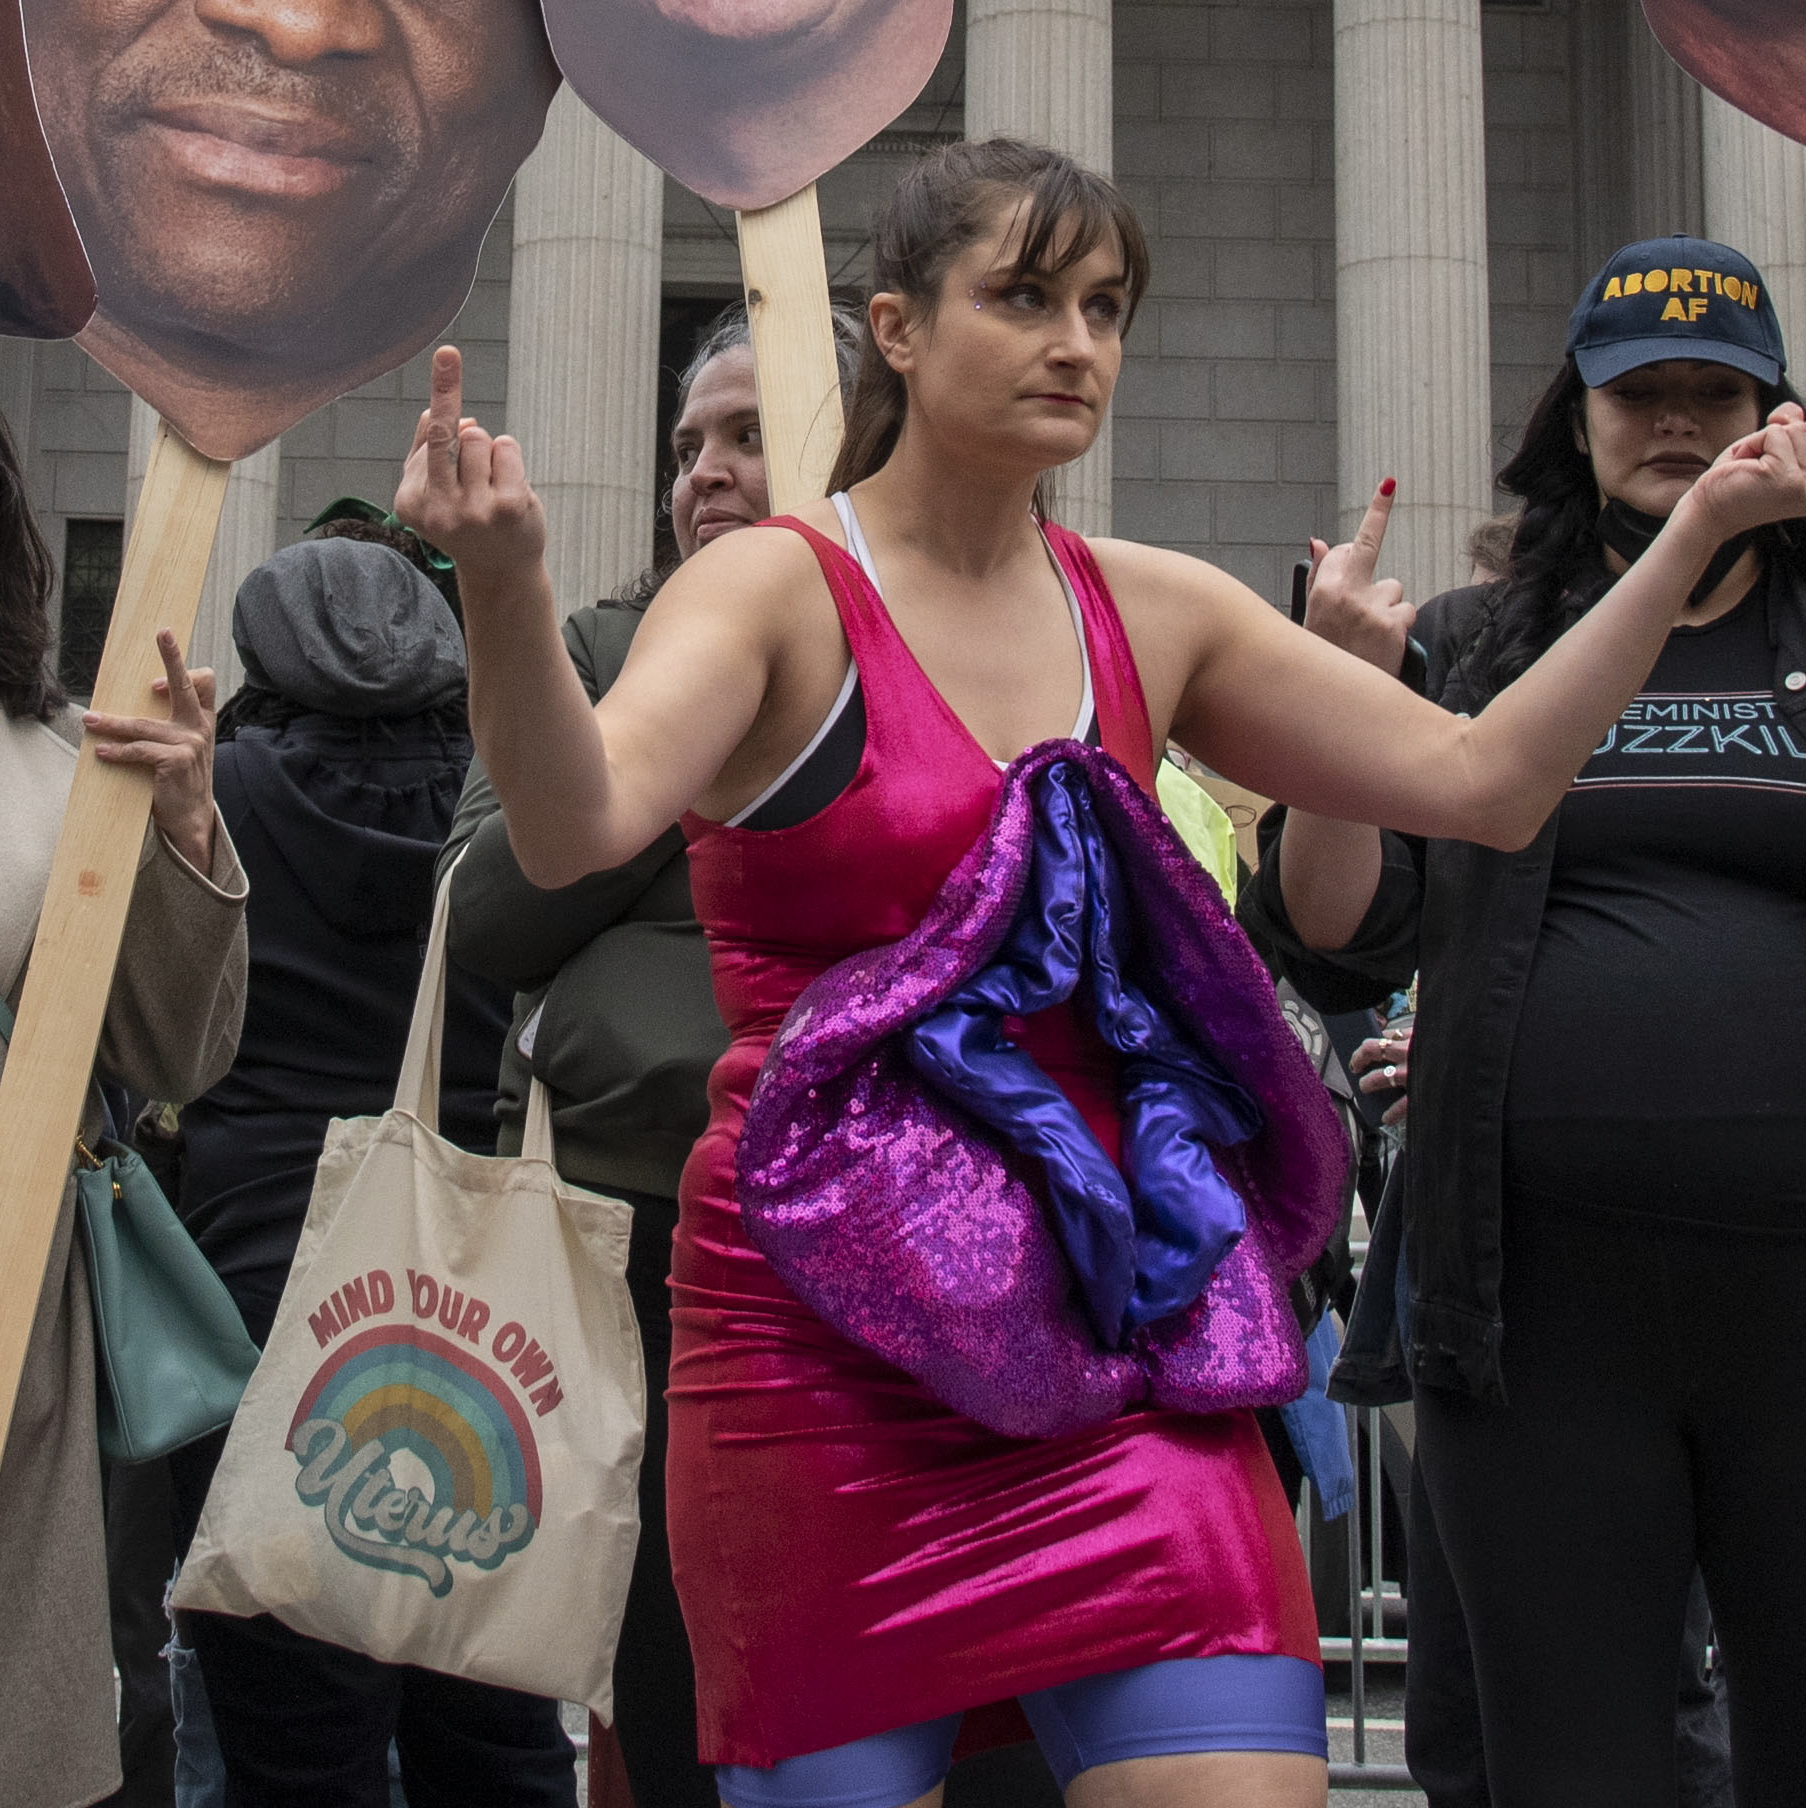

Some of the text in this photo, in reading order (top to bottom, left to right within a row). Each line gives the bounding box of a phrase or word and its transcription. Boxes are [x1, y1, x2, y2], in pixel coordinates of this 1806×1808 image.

[1602, 268, 1759, 310] ABORTION
[1660, 297, 1709, 322] AF
[1619, 702, 1778, 721] EMINIST
[307, 1269, 395, 1349] MIND
[492, 1321, 565, 1417] OWN
[292, 1418, 533, 1594] Uterus
